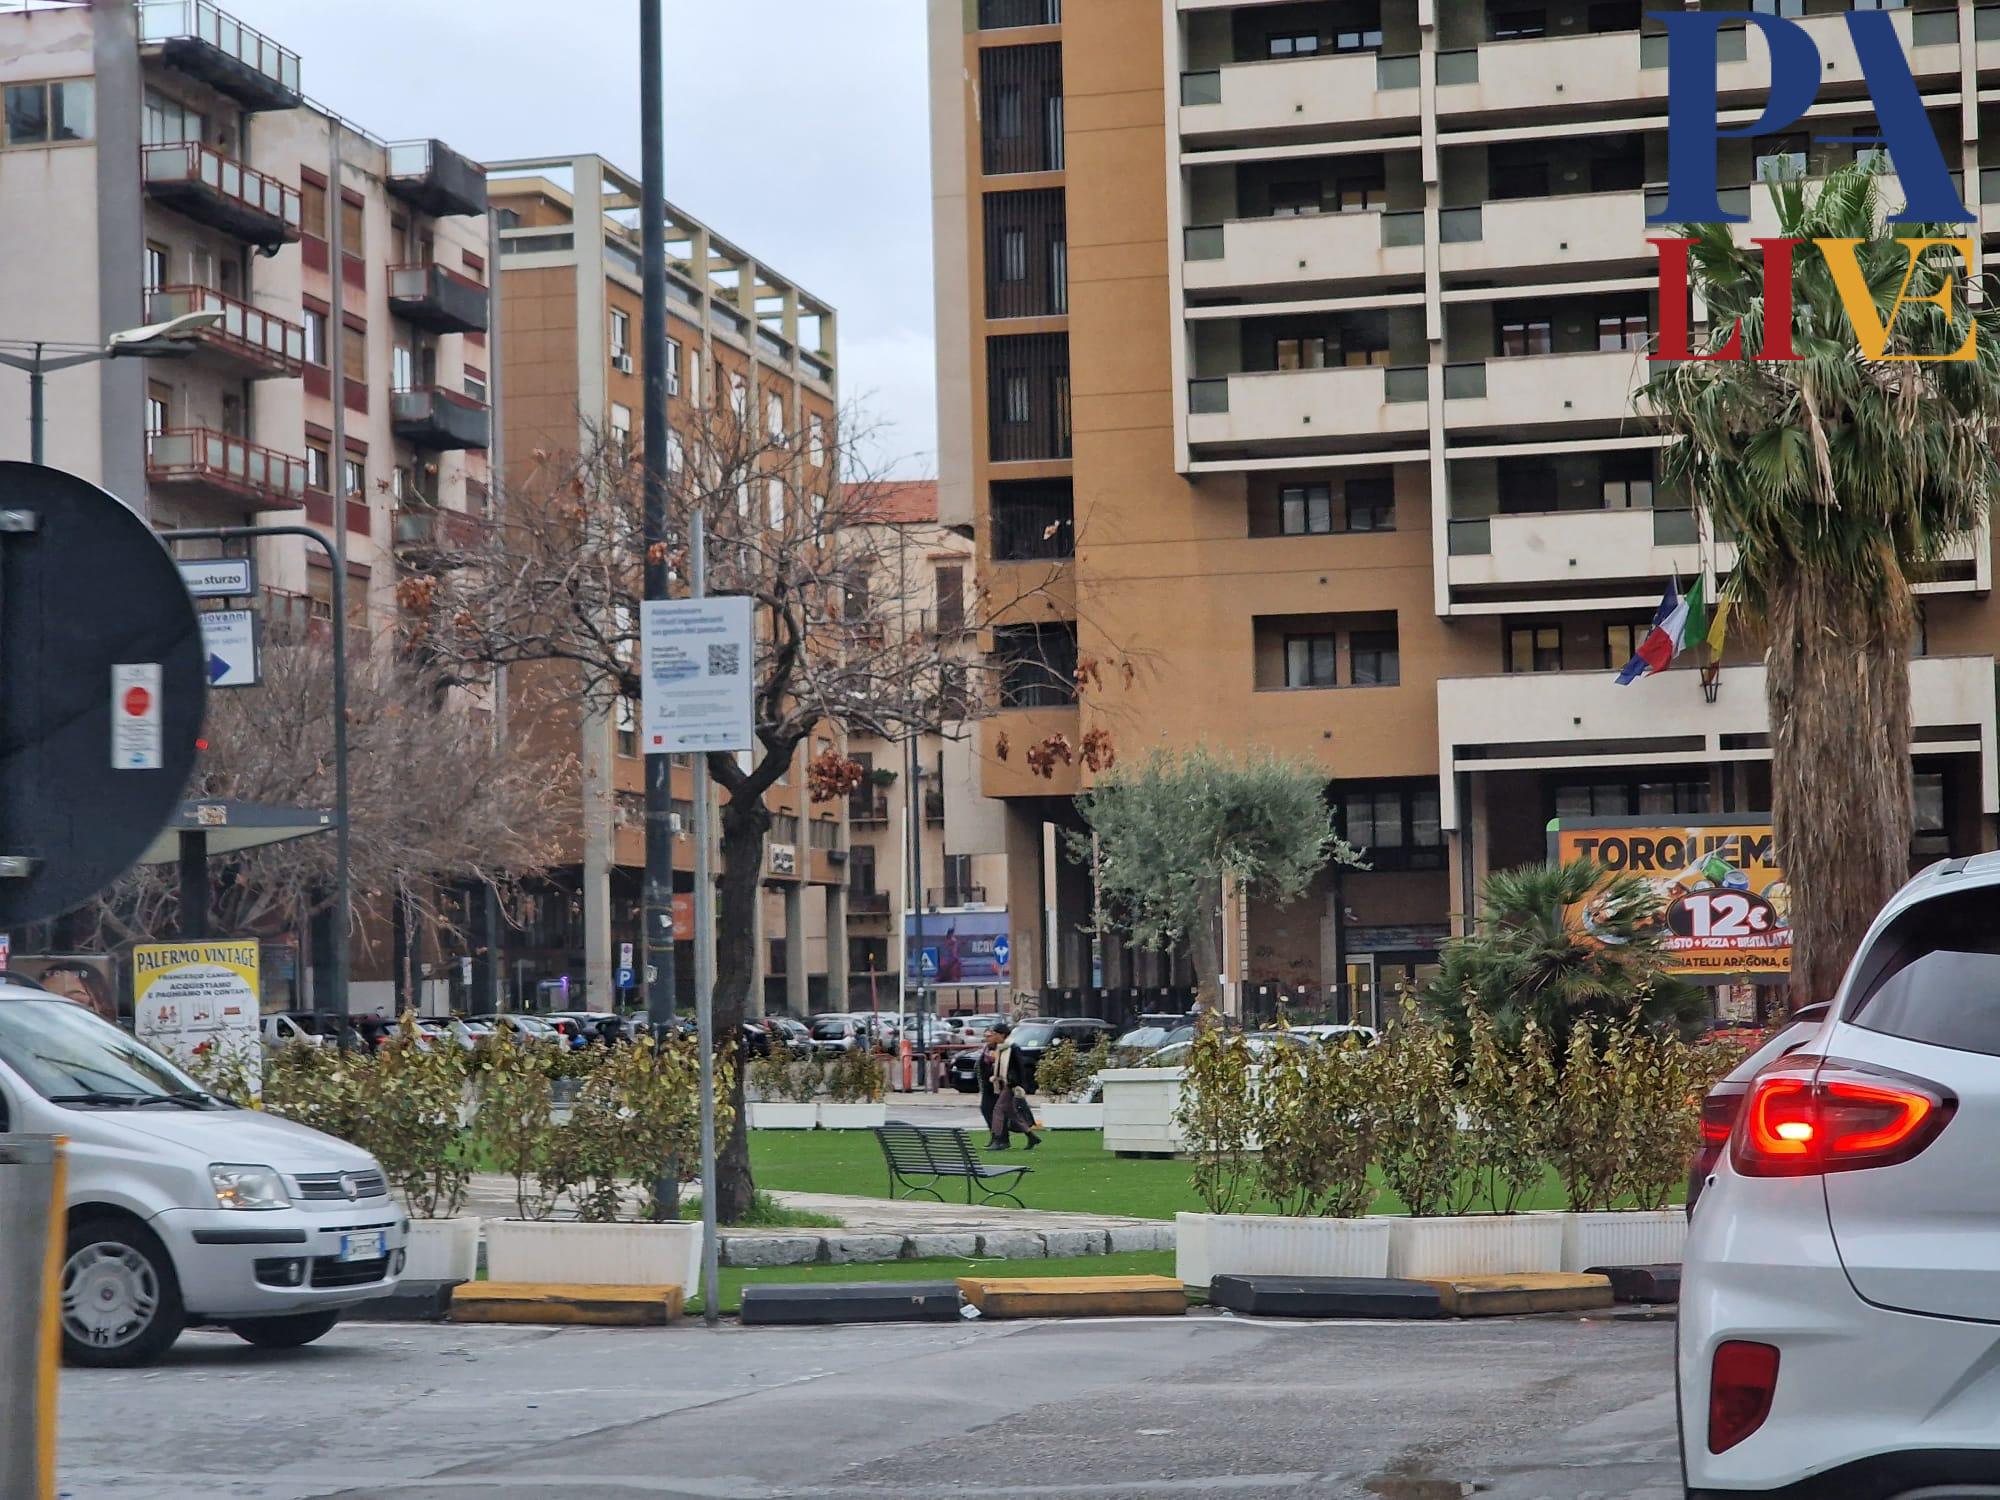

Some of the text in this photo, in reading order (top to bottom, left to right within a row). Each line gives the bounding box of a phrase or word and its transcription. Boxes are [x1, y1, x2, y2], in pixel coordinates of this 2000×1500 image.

[204, 575, 241, 585] sturzo
[1684, 894, 1768, 937] 12€
[1701, 938, 1730, 949] PIZZA
[137, 947, 256, 973] PALERMO VINTAGE
[170, 982, 232, 990] ACQUISTIAMO
